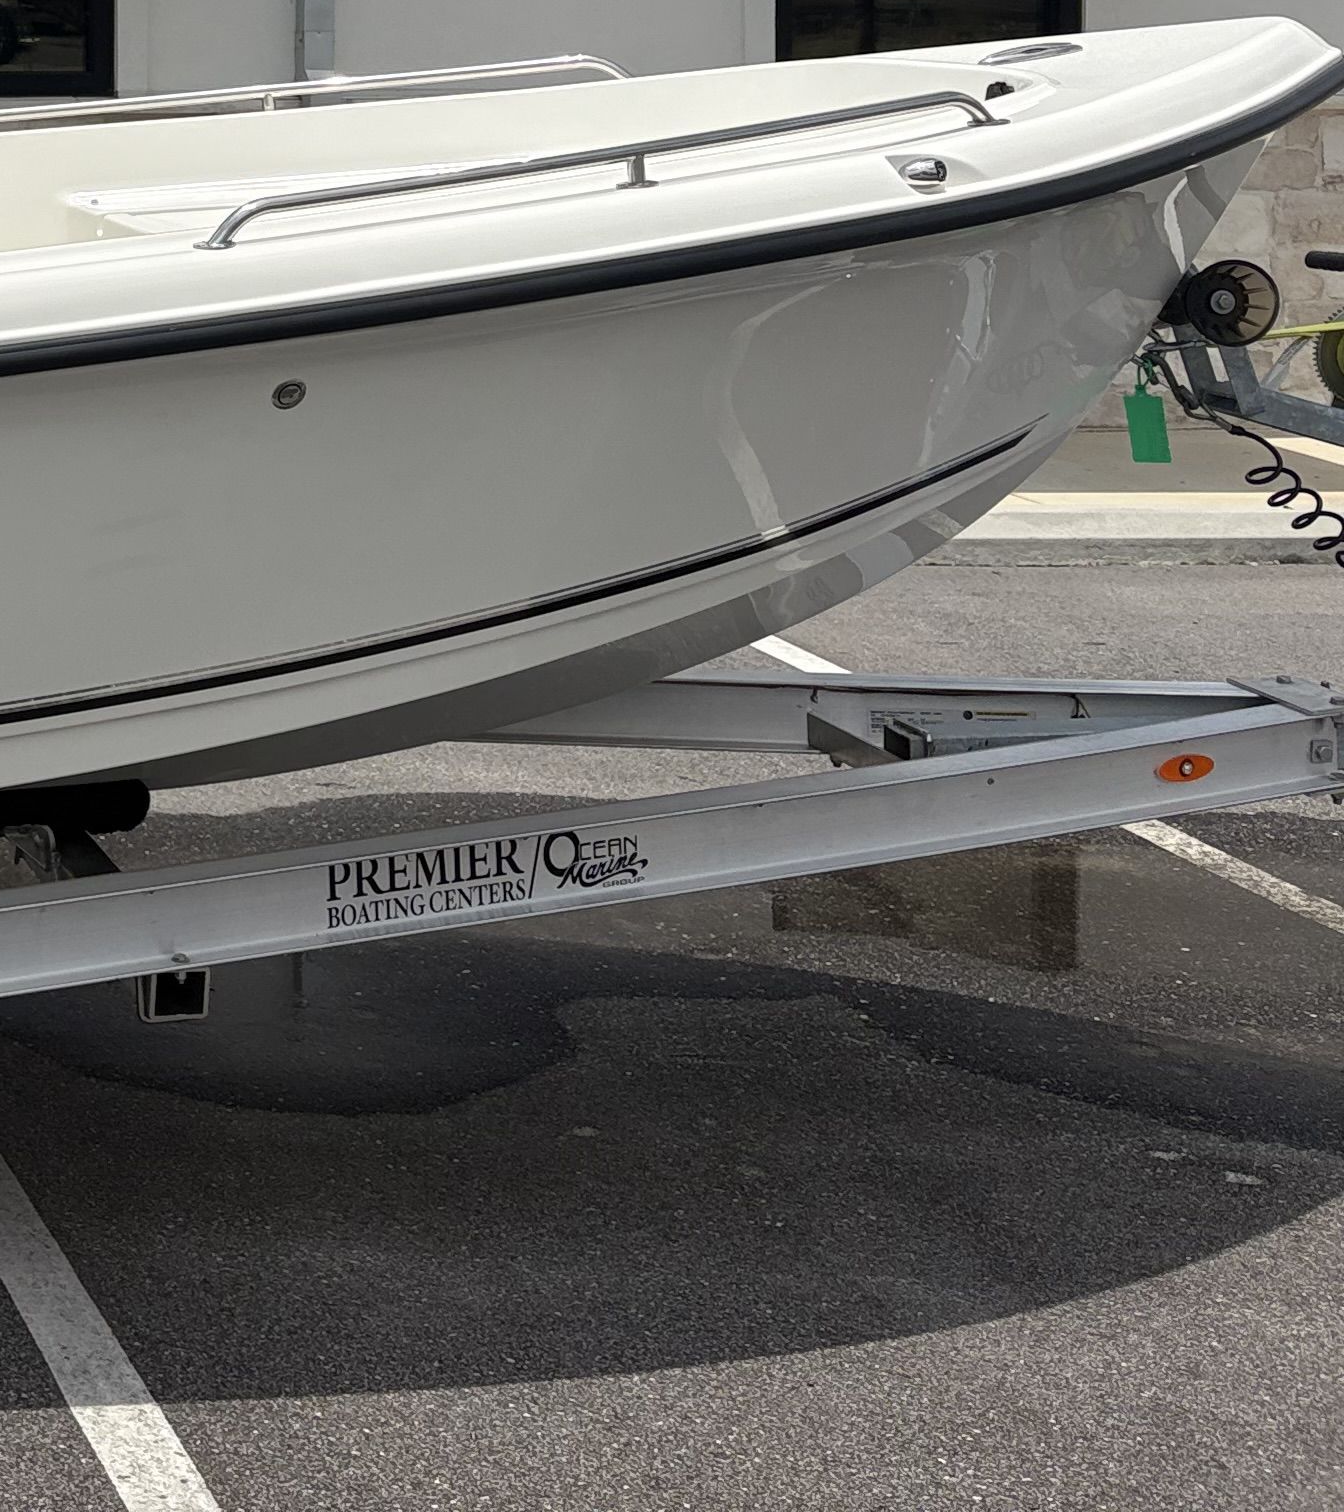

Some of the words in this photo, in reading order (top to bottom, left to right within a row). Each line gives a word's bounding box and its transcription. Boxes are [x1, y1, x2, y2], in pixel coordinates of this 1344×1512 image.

[326, 839, 525, 902] PREMIER
[543, 831, 638, 878] OCEAN
[556, 851, 649, 889] Marine
[327, 893, 426, 929] BOATING
[429, 878, 526, 914] CENTERS
[602, 876, 646, 888] GROUP
